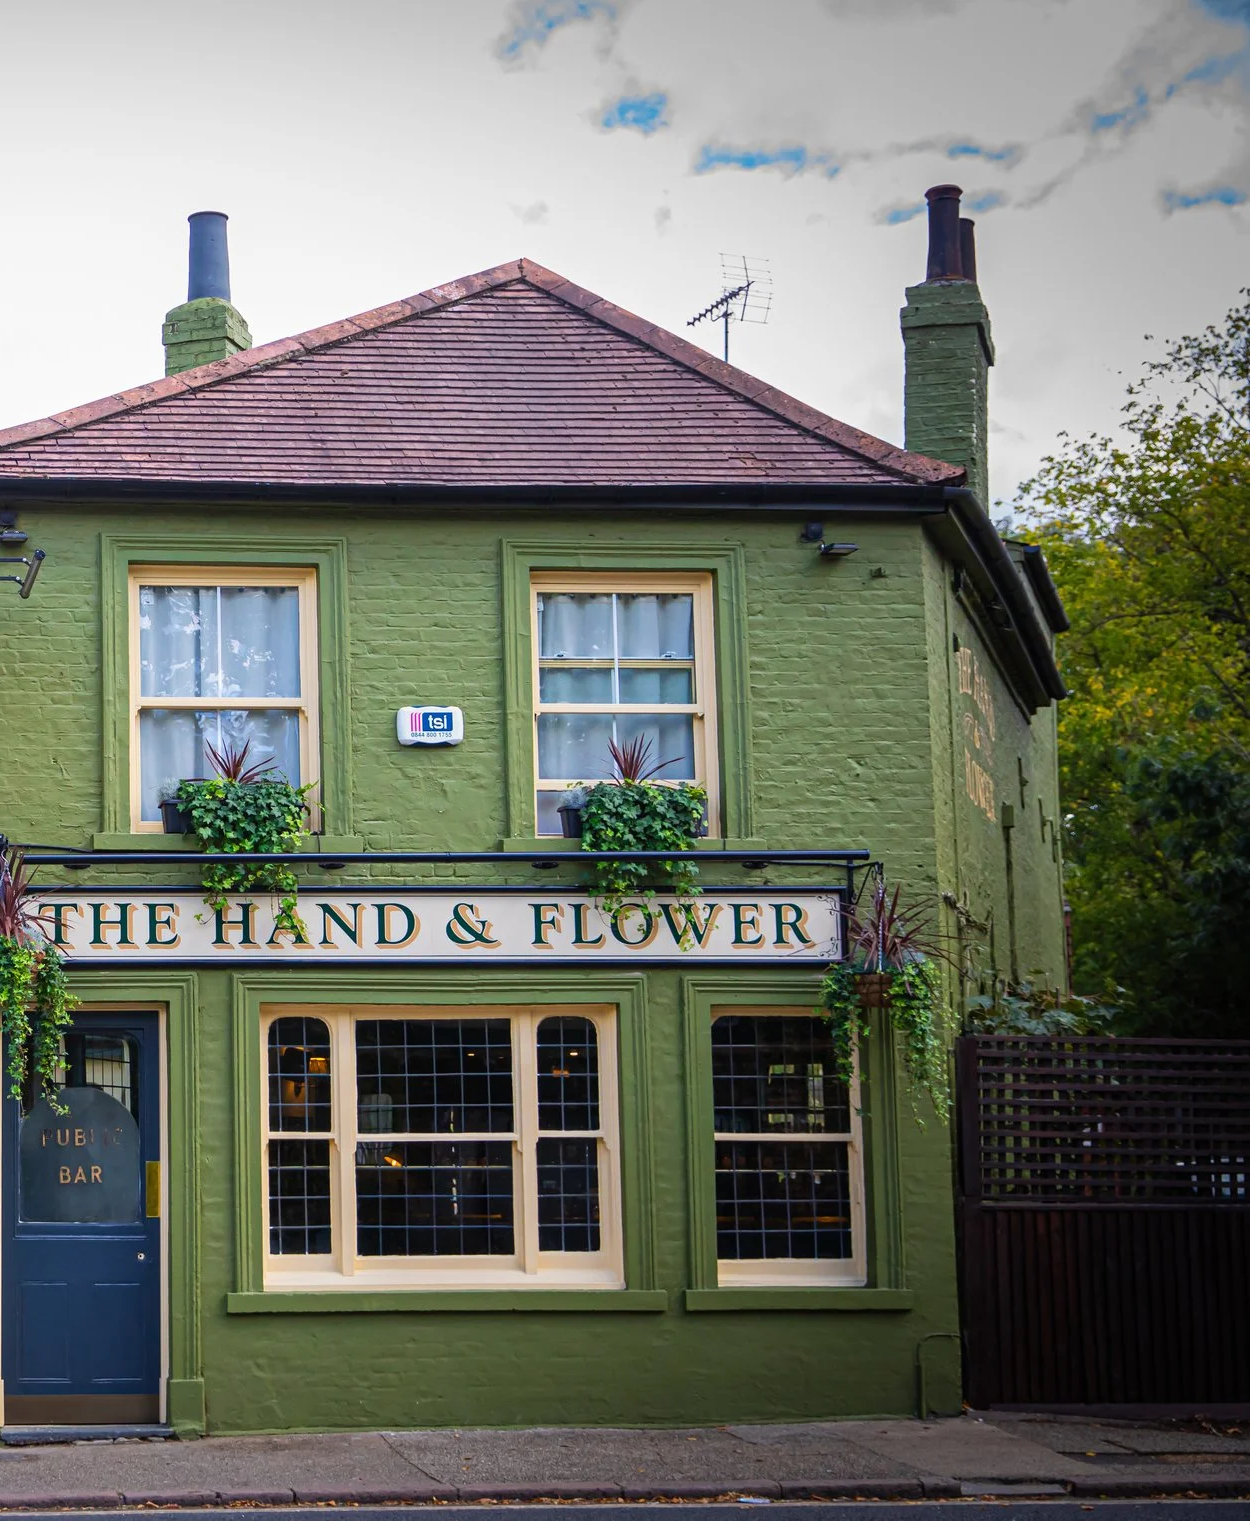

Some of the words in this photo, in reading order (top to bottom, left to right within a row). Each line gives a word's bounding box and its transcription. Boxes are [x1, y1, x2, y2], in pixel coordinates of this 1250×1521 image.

[427, 714, 448, 730] tsi
[38, 902, 182, 949] THE
[208, 901, 421, 949] HAND
[445, 902, 501, 949] &
[528, 901, 815, 949] FLOWER
[59, 1165, 103, 1184] BAR
